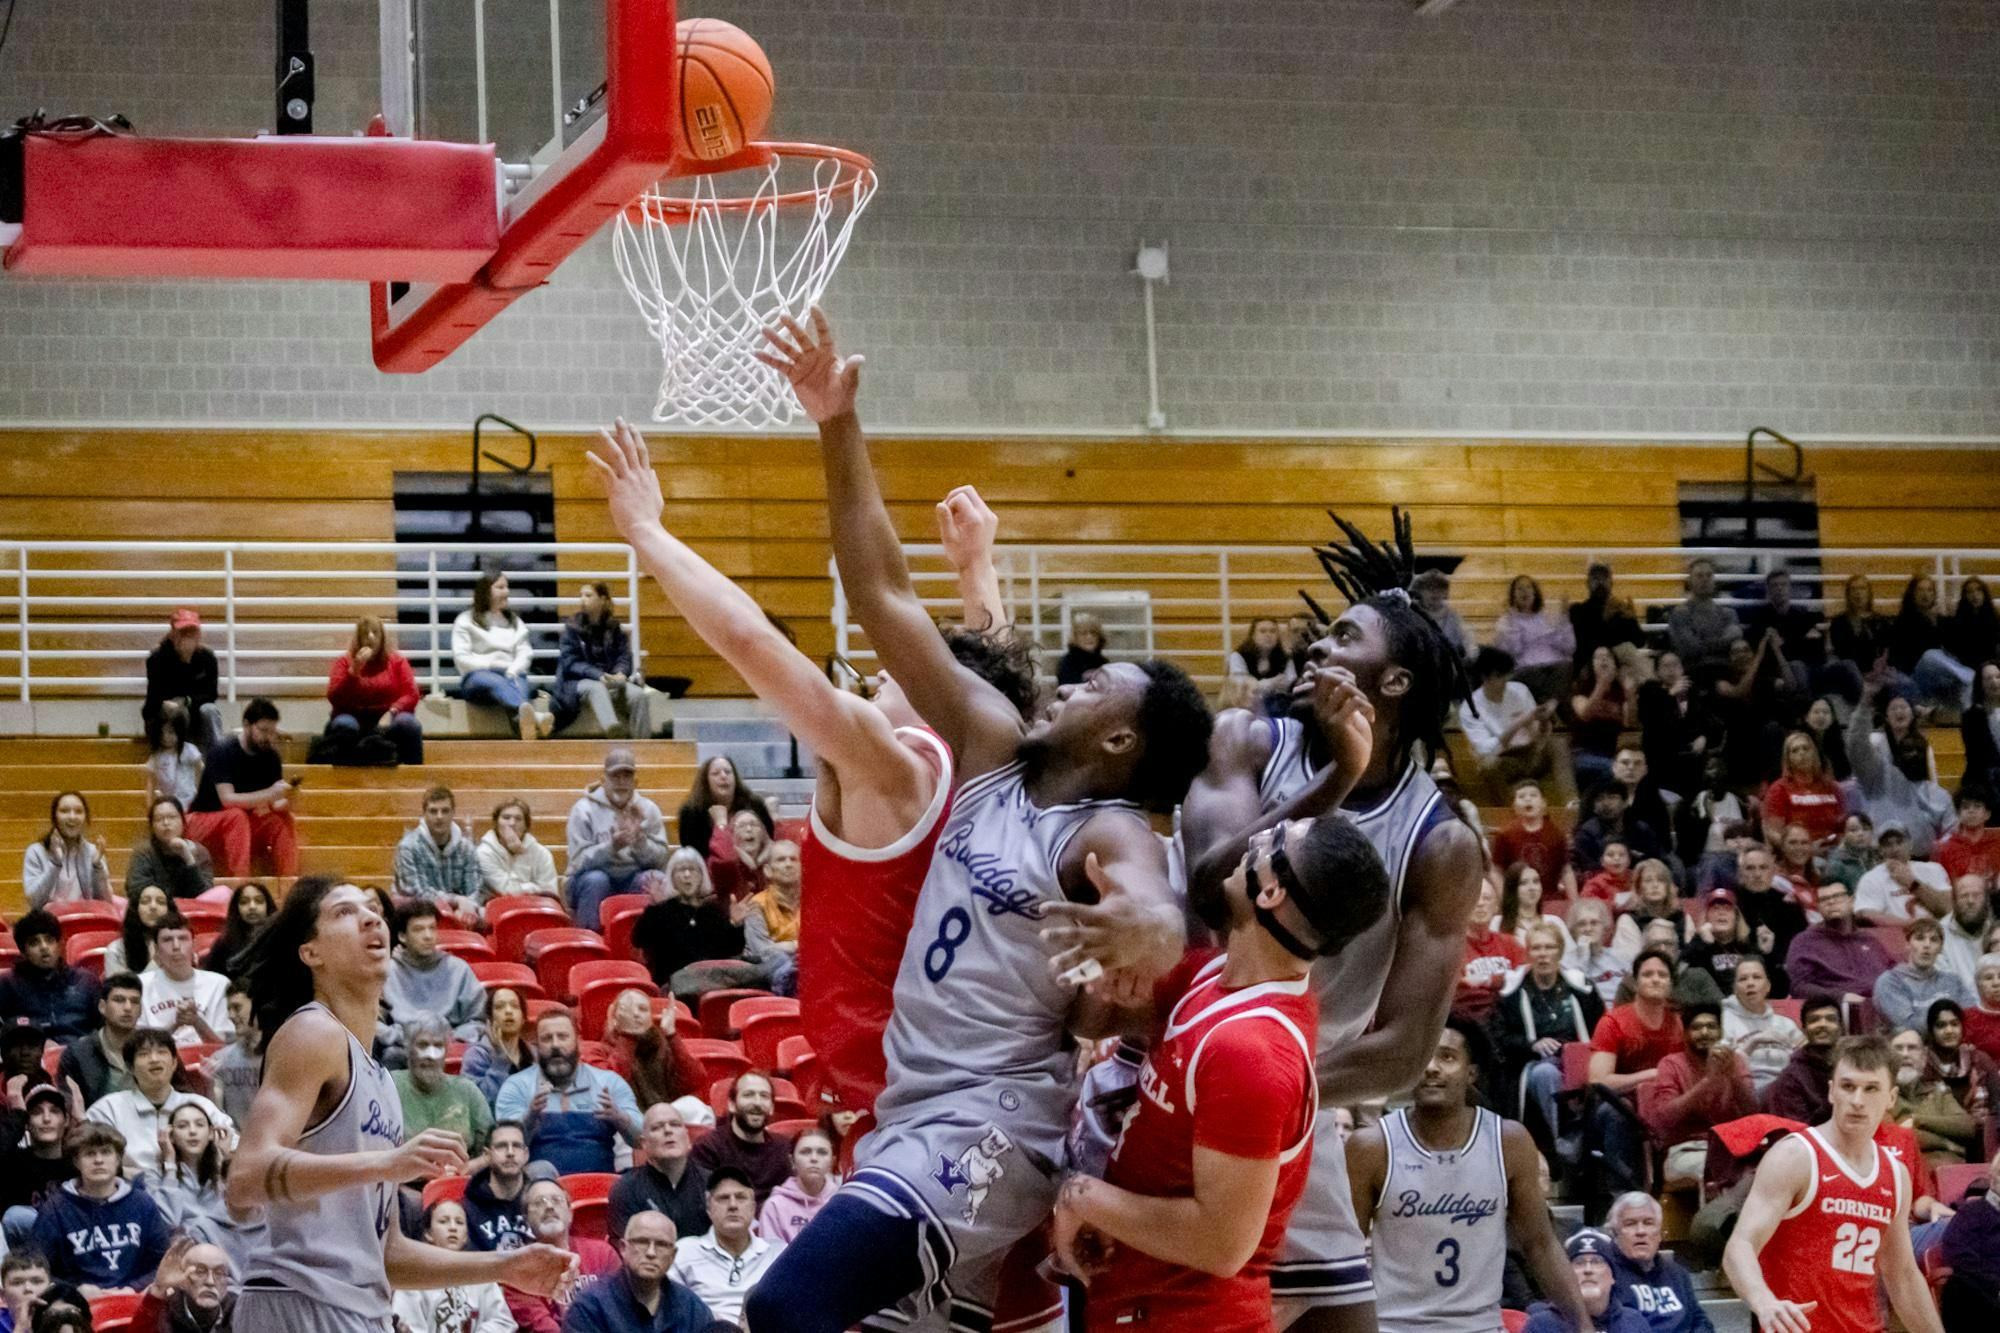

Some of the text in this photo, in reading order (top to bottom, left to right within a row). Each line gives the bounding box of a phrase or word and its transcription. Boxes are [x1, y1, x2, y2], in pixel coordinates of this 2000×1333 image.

[924, 906, 972, 984] 8
[1392, 1189, 1499, 1226] Bulldogs
[1821, 1196, 1892, 1225] CORNELL
[101, 1249, 121, 1271] Y
[1434, 1237, 1461, 1288] 3
[1831, 1221, 1882, 1275] 22
